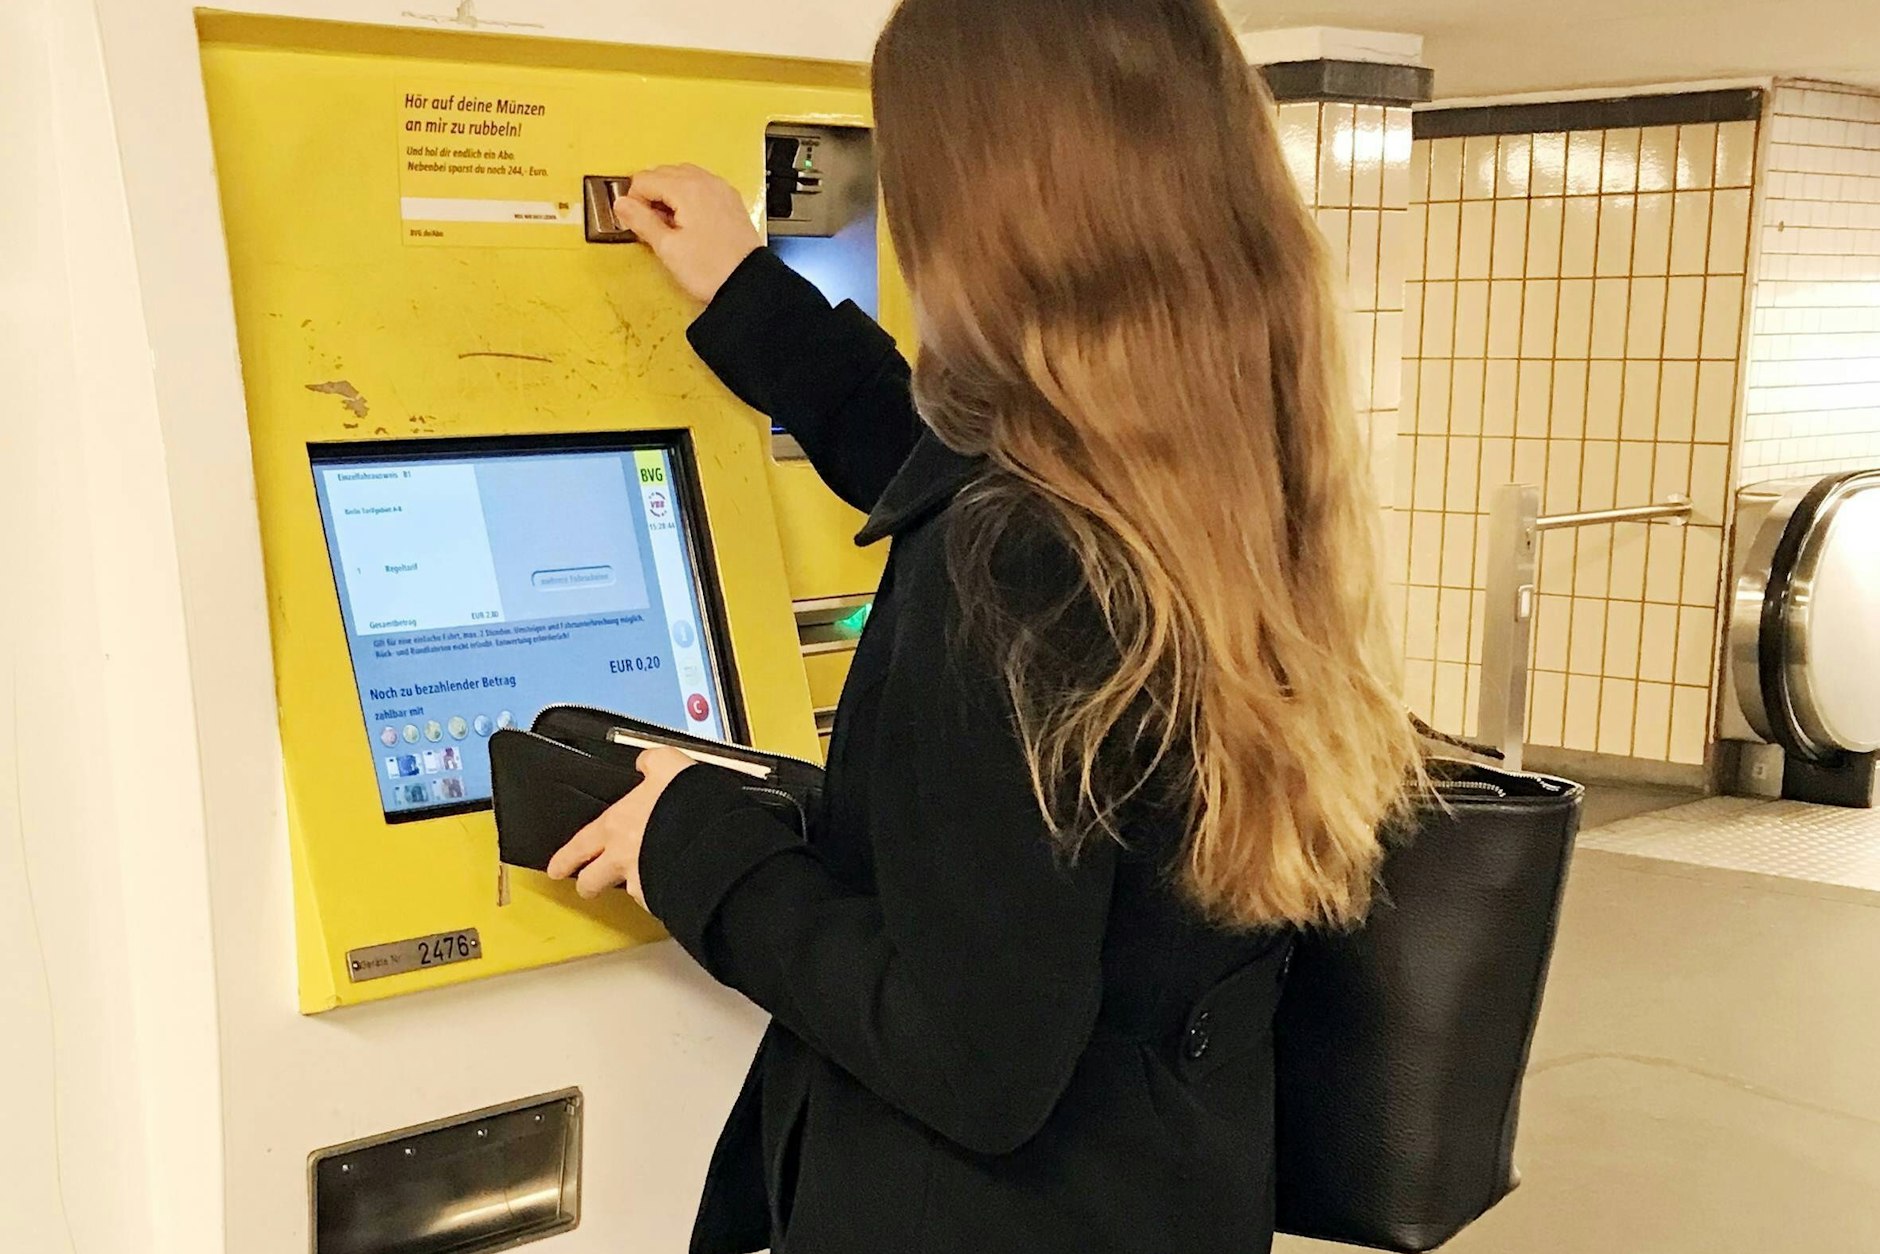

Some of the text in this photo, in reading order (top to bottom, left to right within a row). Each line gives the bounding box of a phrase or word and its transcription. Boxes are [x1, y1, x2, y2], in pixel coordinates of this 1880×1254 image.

[405, 93, 545, 116] Hör auf deine Münzen
[405, 117, 522, 137] an mir zu rubbeln!
[406, 146, 423, 156] Und
[440, 147, 451, 157] dir
[453, 148, 482, 158] endlich
[484, 150, 496, 159] ein
[408, 161, 446, 172] Nebenbei
[448, 164, 473, 175] sparst
[475, 164, 485, 174] du
[640, 467, 663, 482] BVG
[609, 655, 661, 674] EUR 0,20
[370, 676, 517, 700] Noch zu bezahlender Betrag
[375, 706, 424, 720] zahlbar mit
[418, 935, 469, 965] 2476
